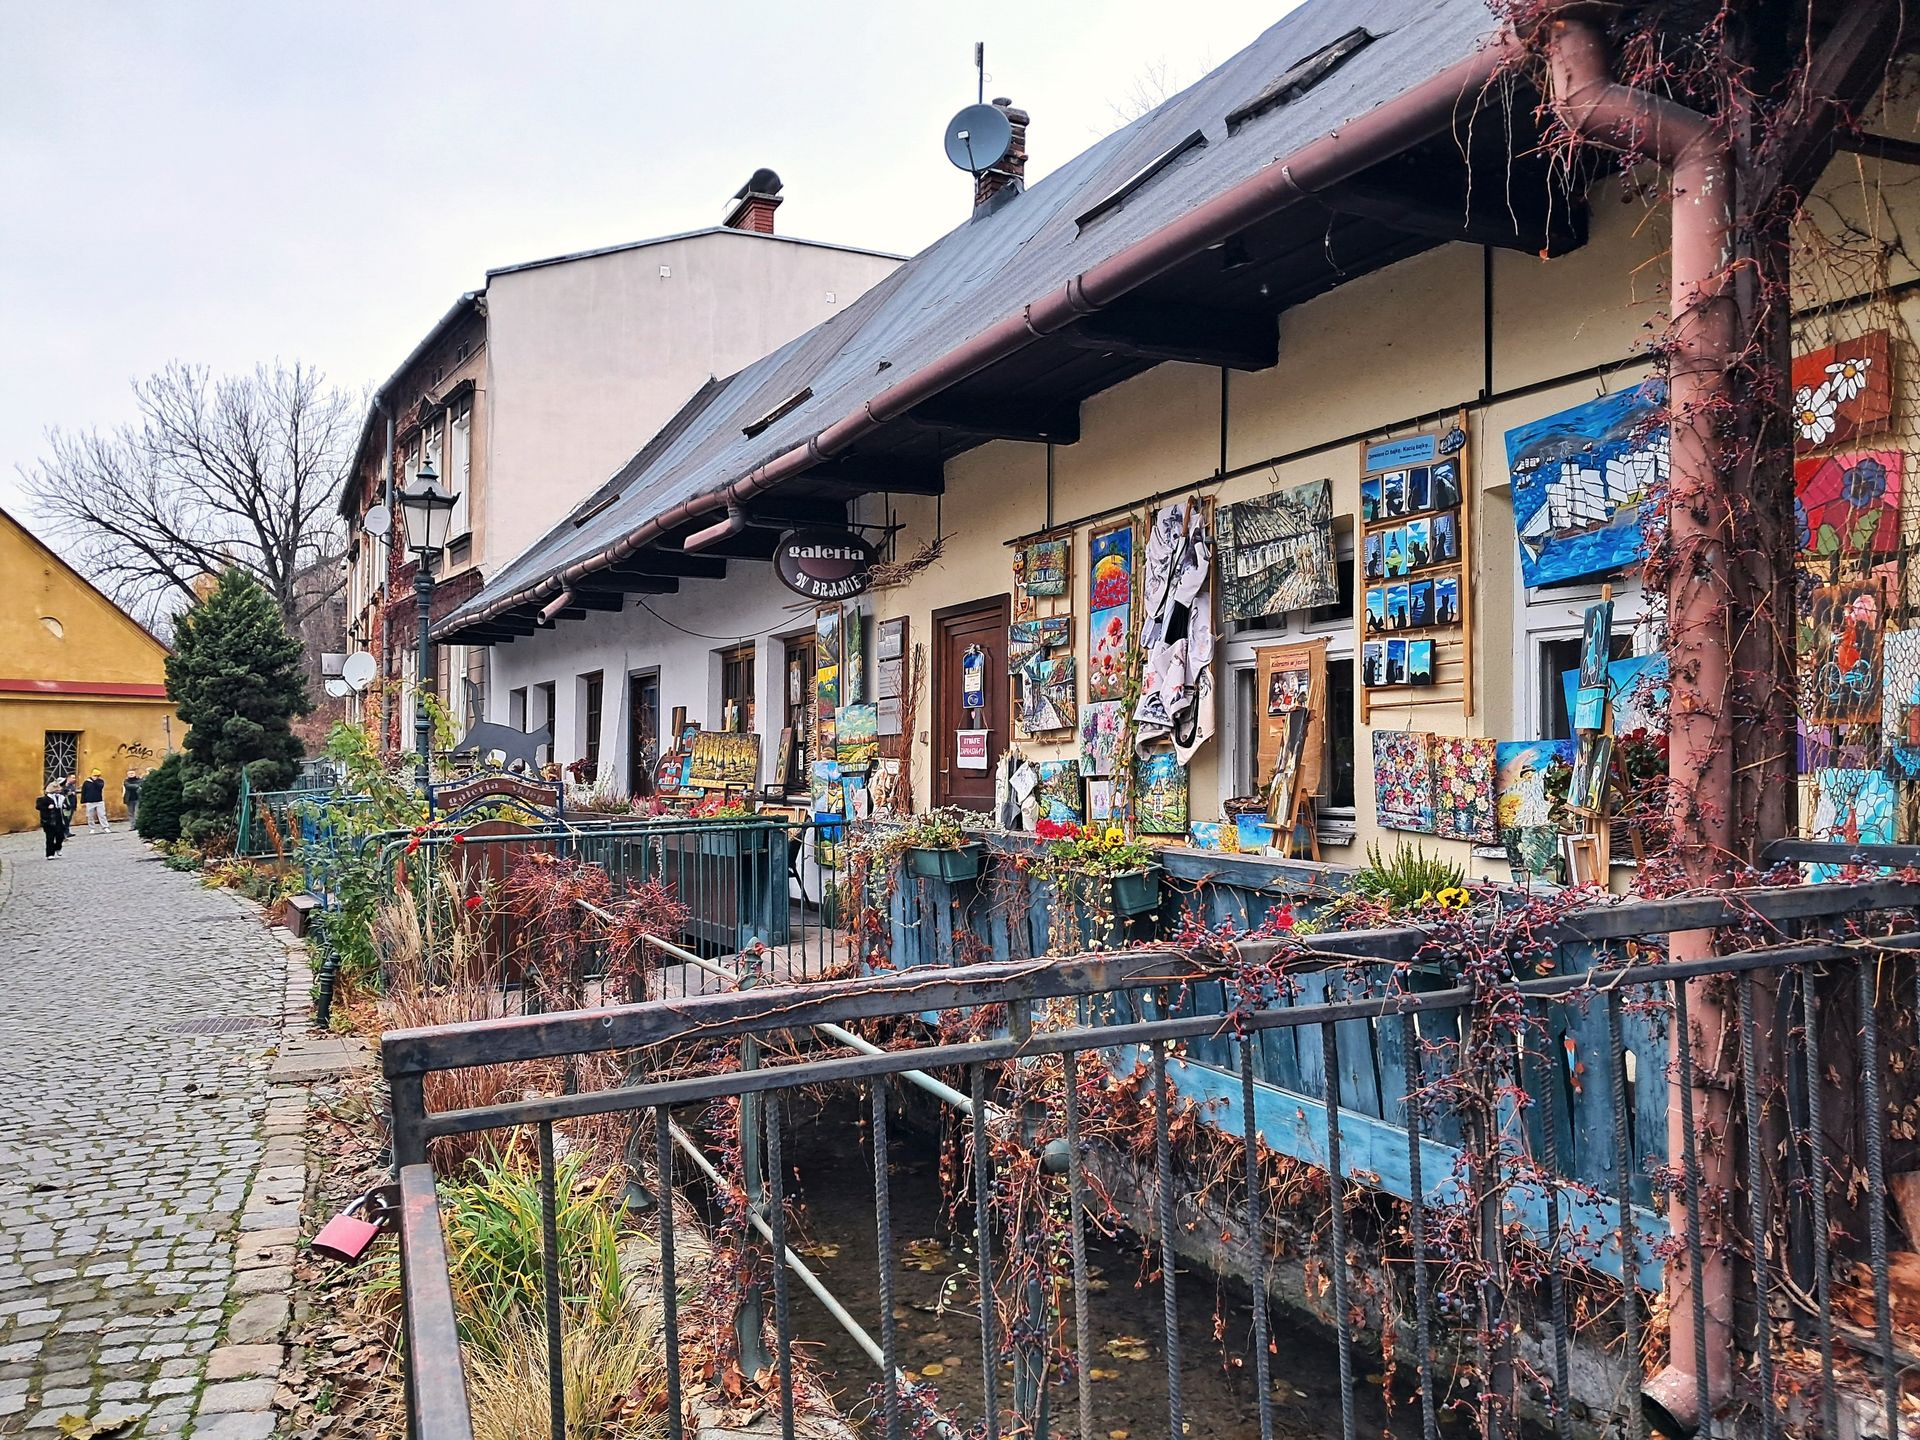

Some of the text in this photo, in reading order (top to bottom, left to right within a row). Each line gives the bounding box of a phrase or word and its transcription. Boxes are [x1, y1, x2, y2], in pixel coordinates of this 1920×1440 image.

[788, 545, 864, 560] galeria
[811, 575, 862, 597] BRAMIE
[448, 782, 546, 806] galeria sklep
